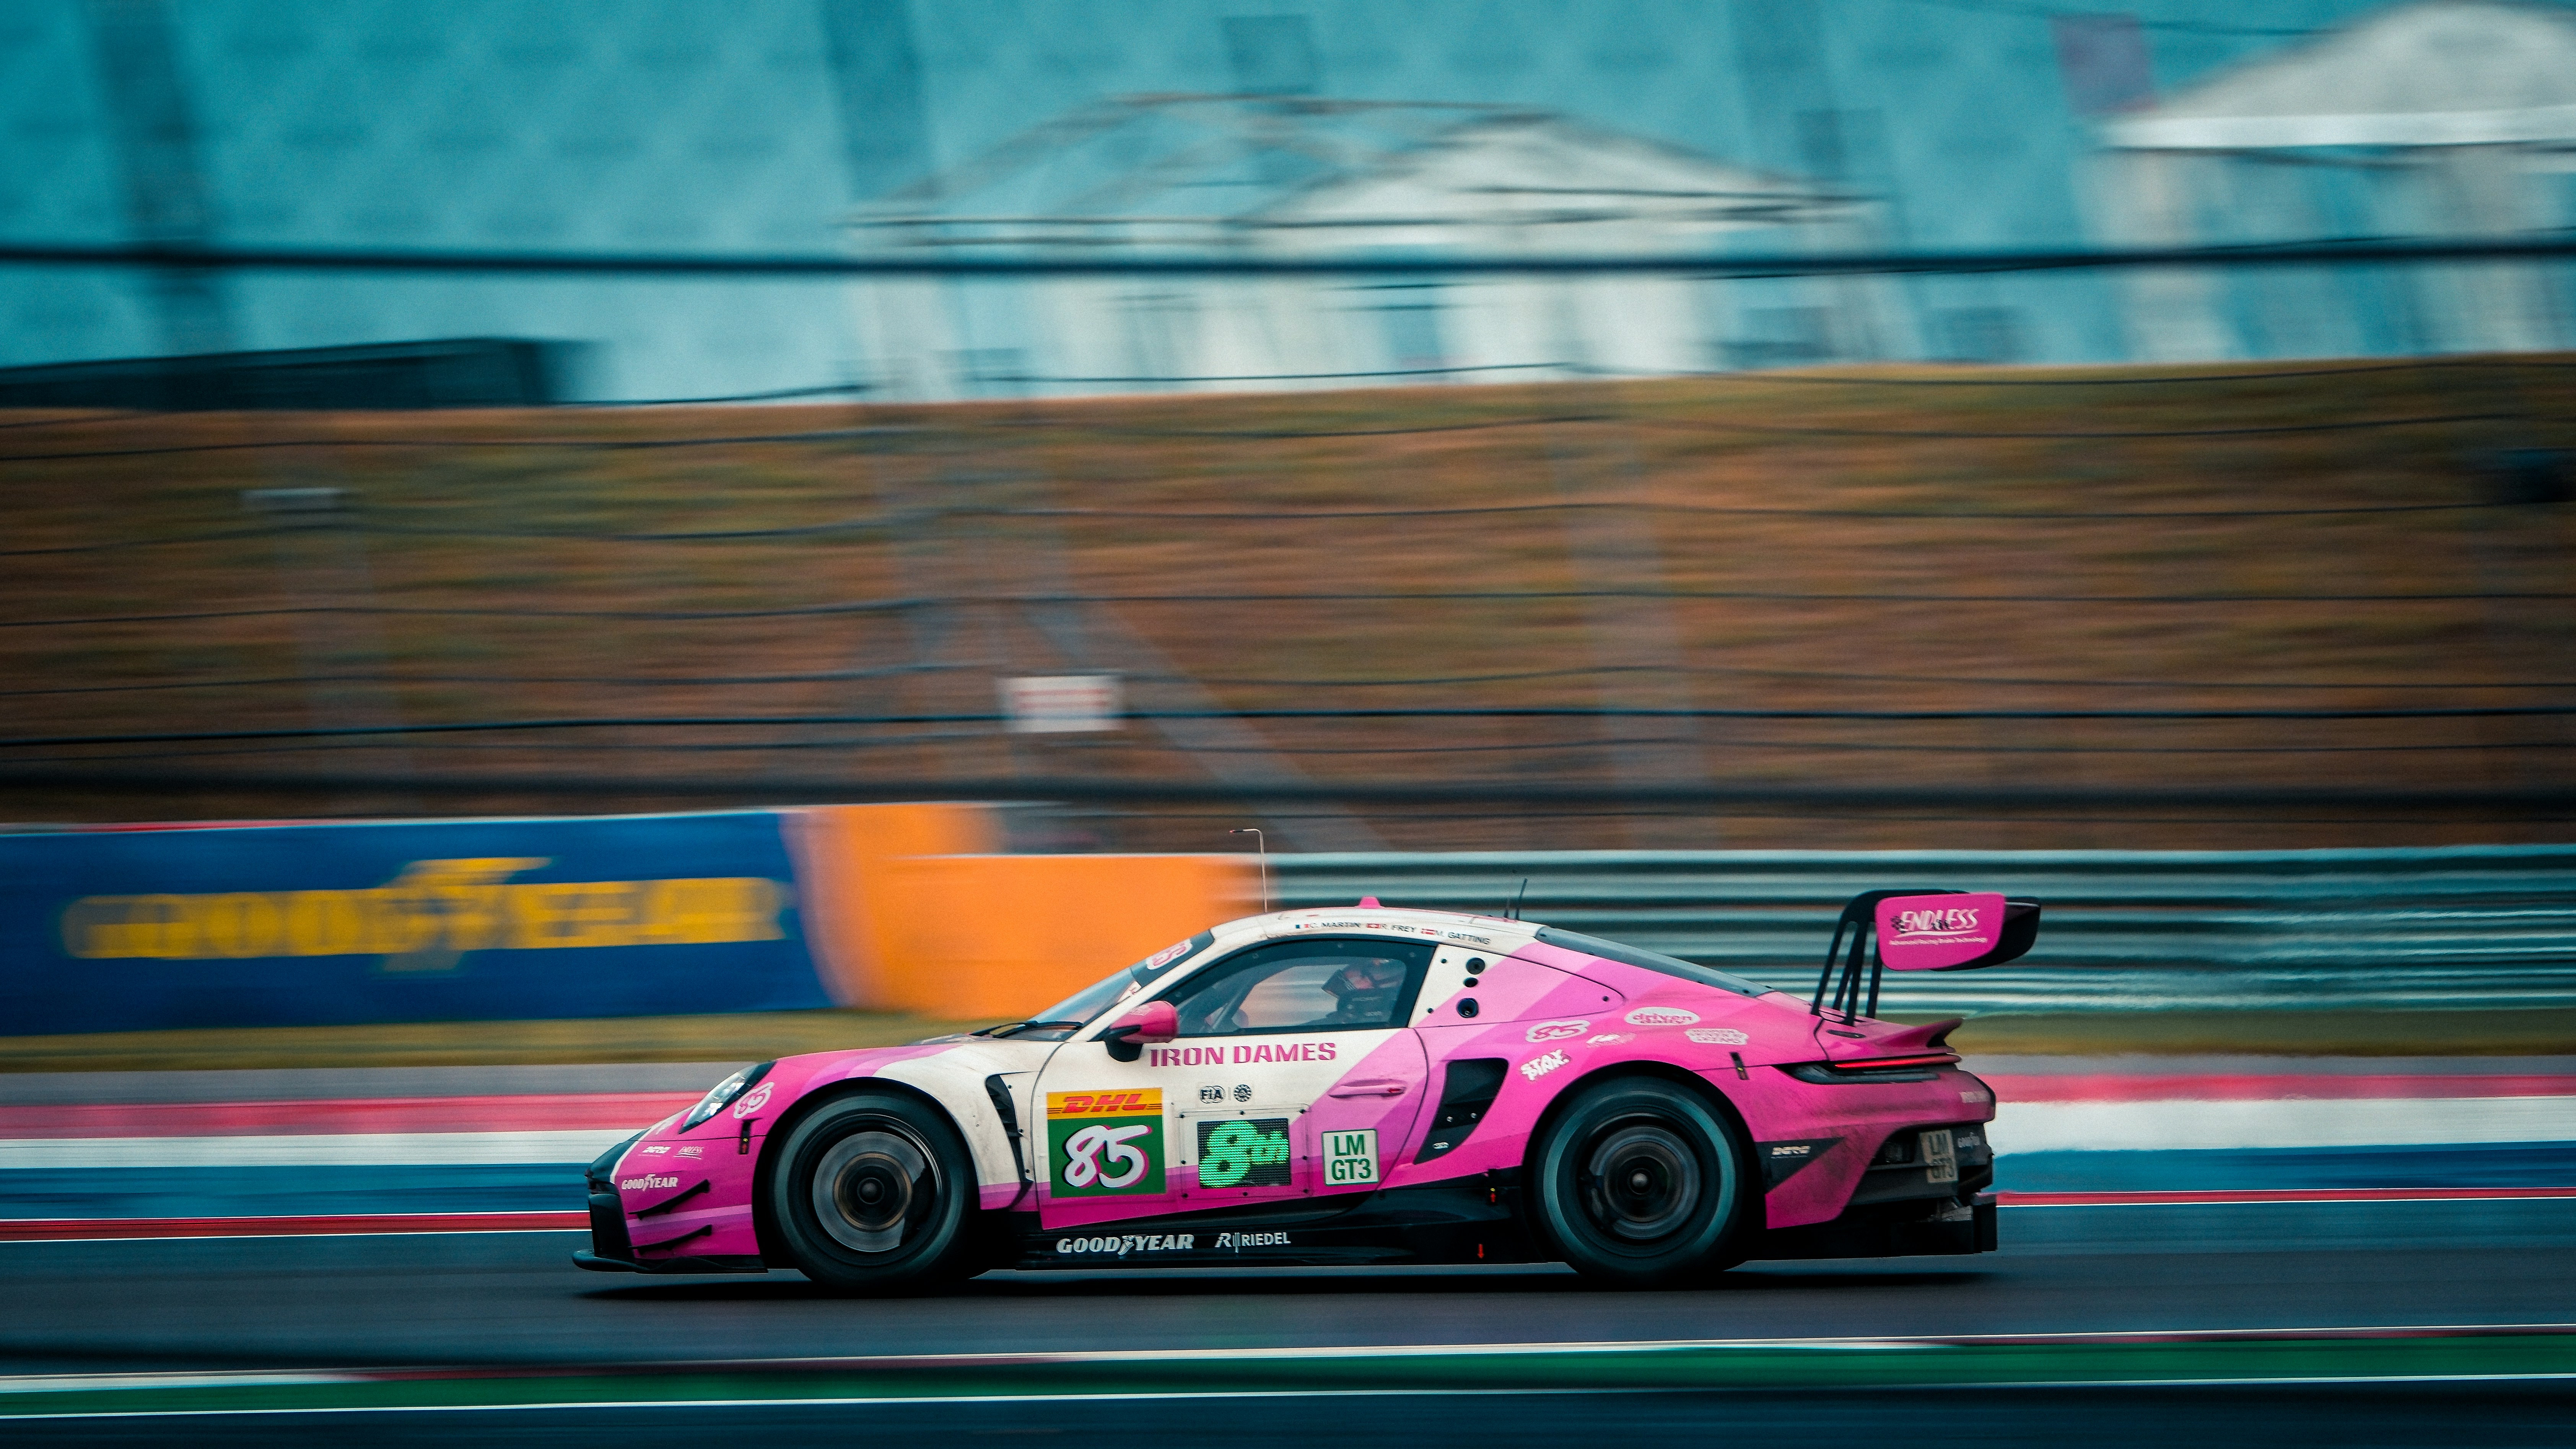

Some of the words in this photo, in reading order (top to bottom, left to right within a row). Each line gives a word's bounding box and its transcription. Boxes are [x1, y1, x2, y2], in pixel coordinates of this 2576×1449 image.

[1391, 924, 1417, 933] FREY
[1900, 908, 1979, 931] ENDLESS
[1448, 932, 1491, 945] GATTING
[1150, 1046, 1224, 1067] IRON
[1233, 1042, 1337, 1064] DAMES
[1062, 1093, 1147, 1114] DHL
[1063, 1124, 1152, 1188] 85
[1198, 1121, 1289, 1187] 8th
[1334, 1133, 1365, 1157] LM
[1331, 1158, 1372, 1181] GT3
[621, 1174, 679, 1192] GOODYEAR
[1056, 1234, 1194, 1255] GOODYEAR
[1241, 1232, 1291, 1246] RIEDEL
